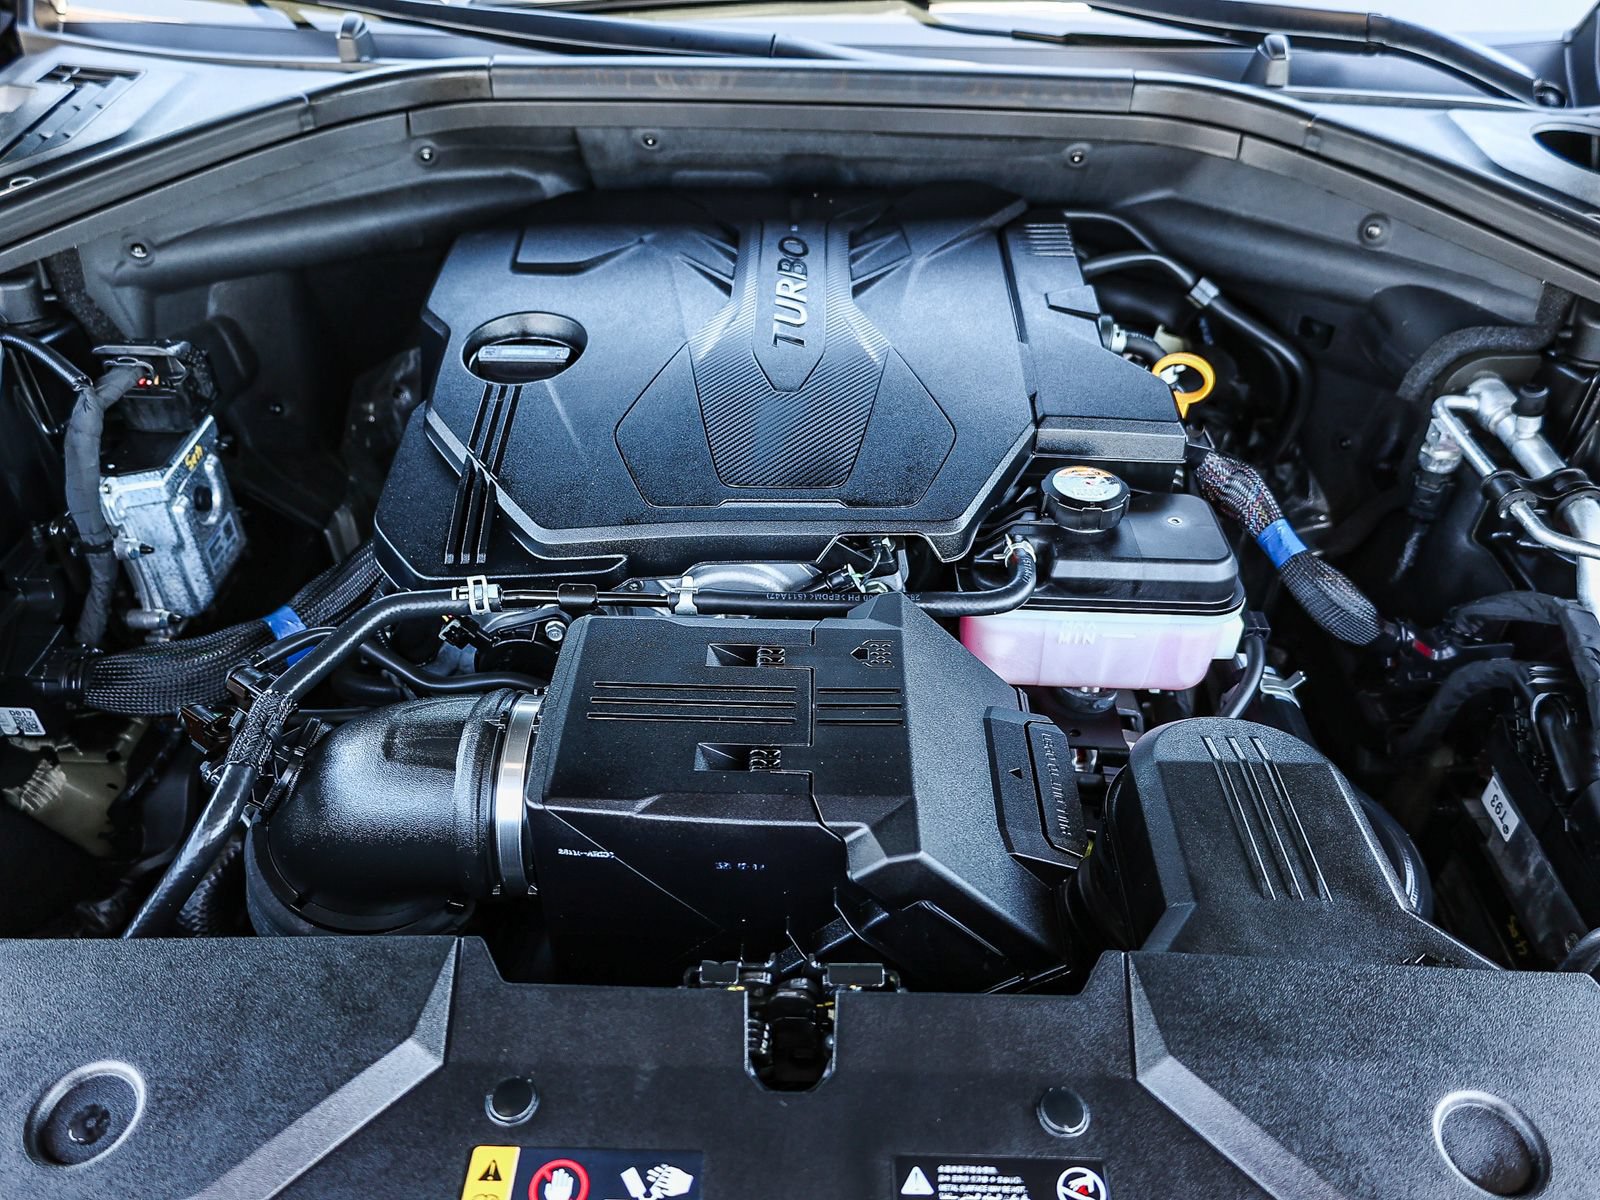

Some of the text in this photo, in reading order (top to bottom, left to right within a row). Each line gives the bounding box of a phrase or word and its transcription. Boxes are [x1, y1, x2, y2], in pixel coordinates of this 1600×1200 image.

[771, 236, 809, 348] TURBO
[1058, 632, 1097, 645] MIN
[1490, 794, 1507, 825] T93
